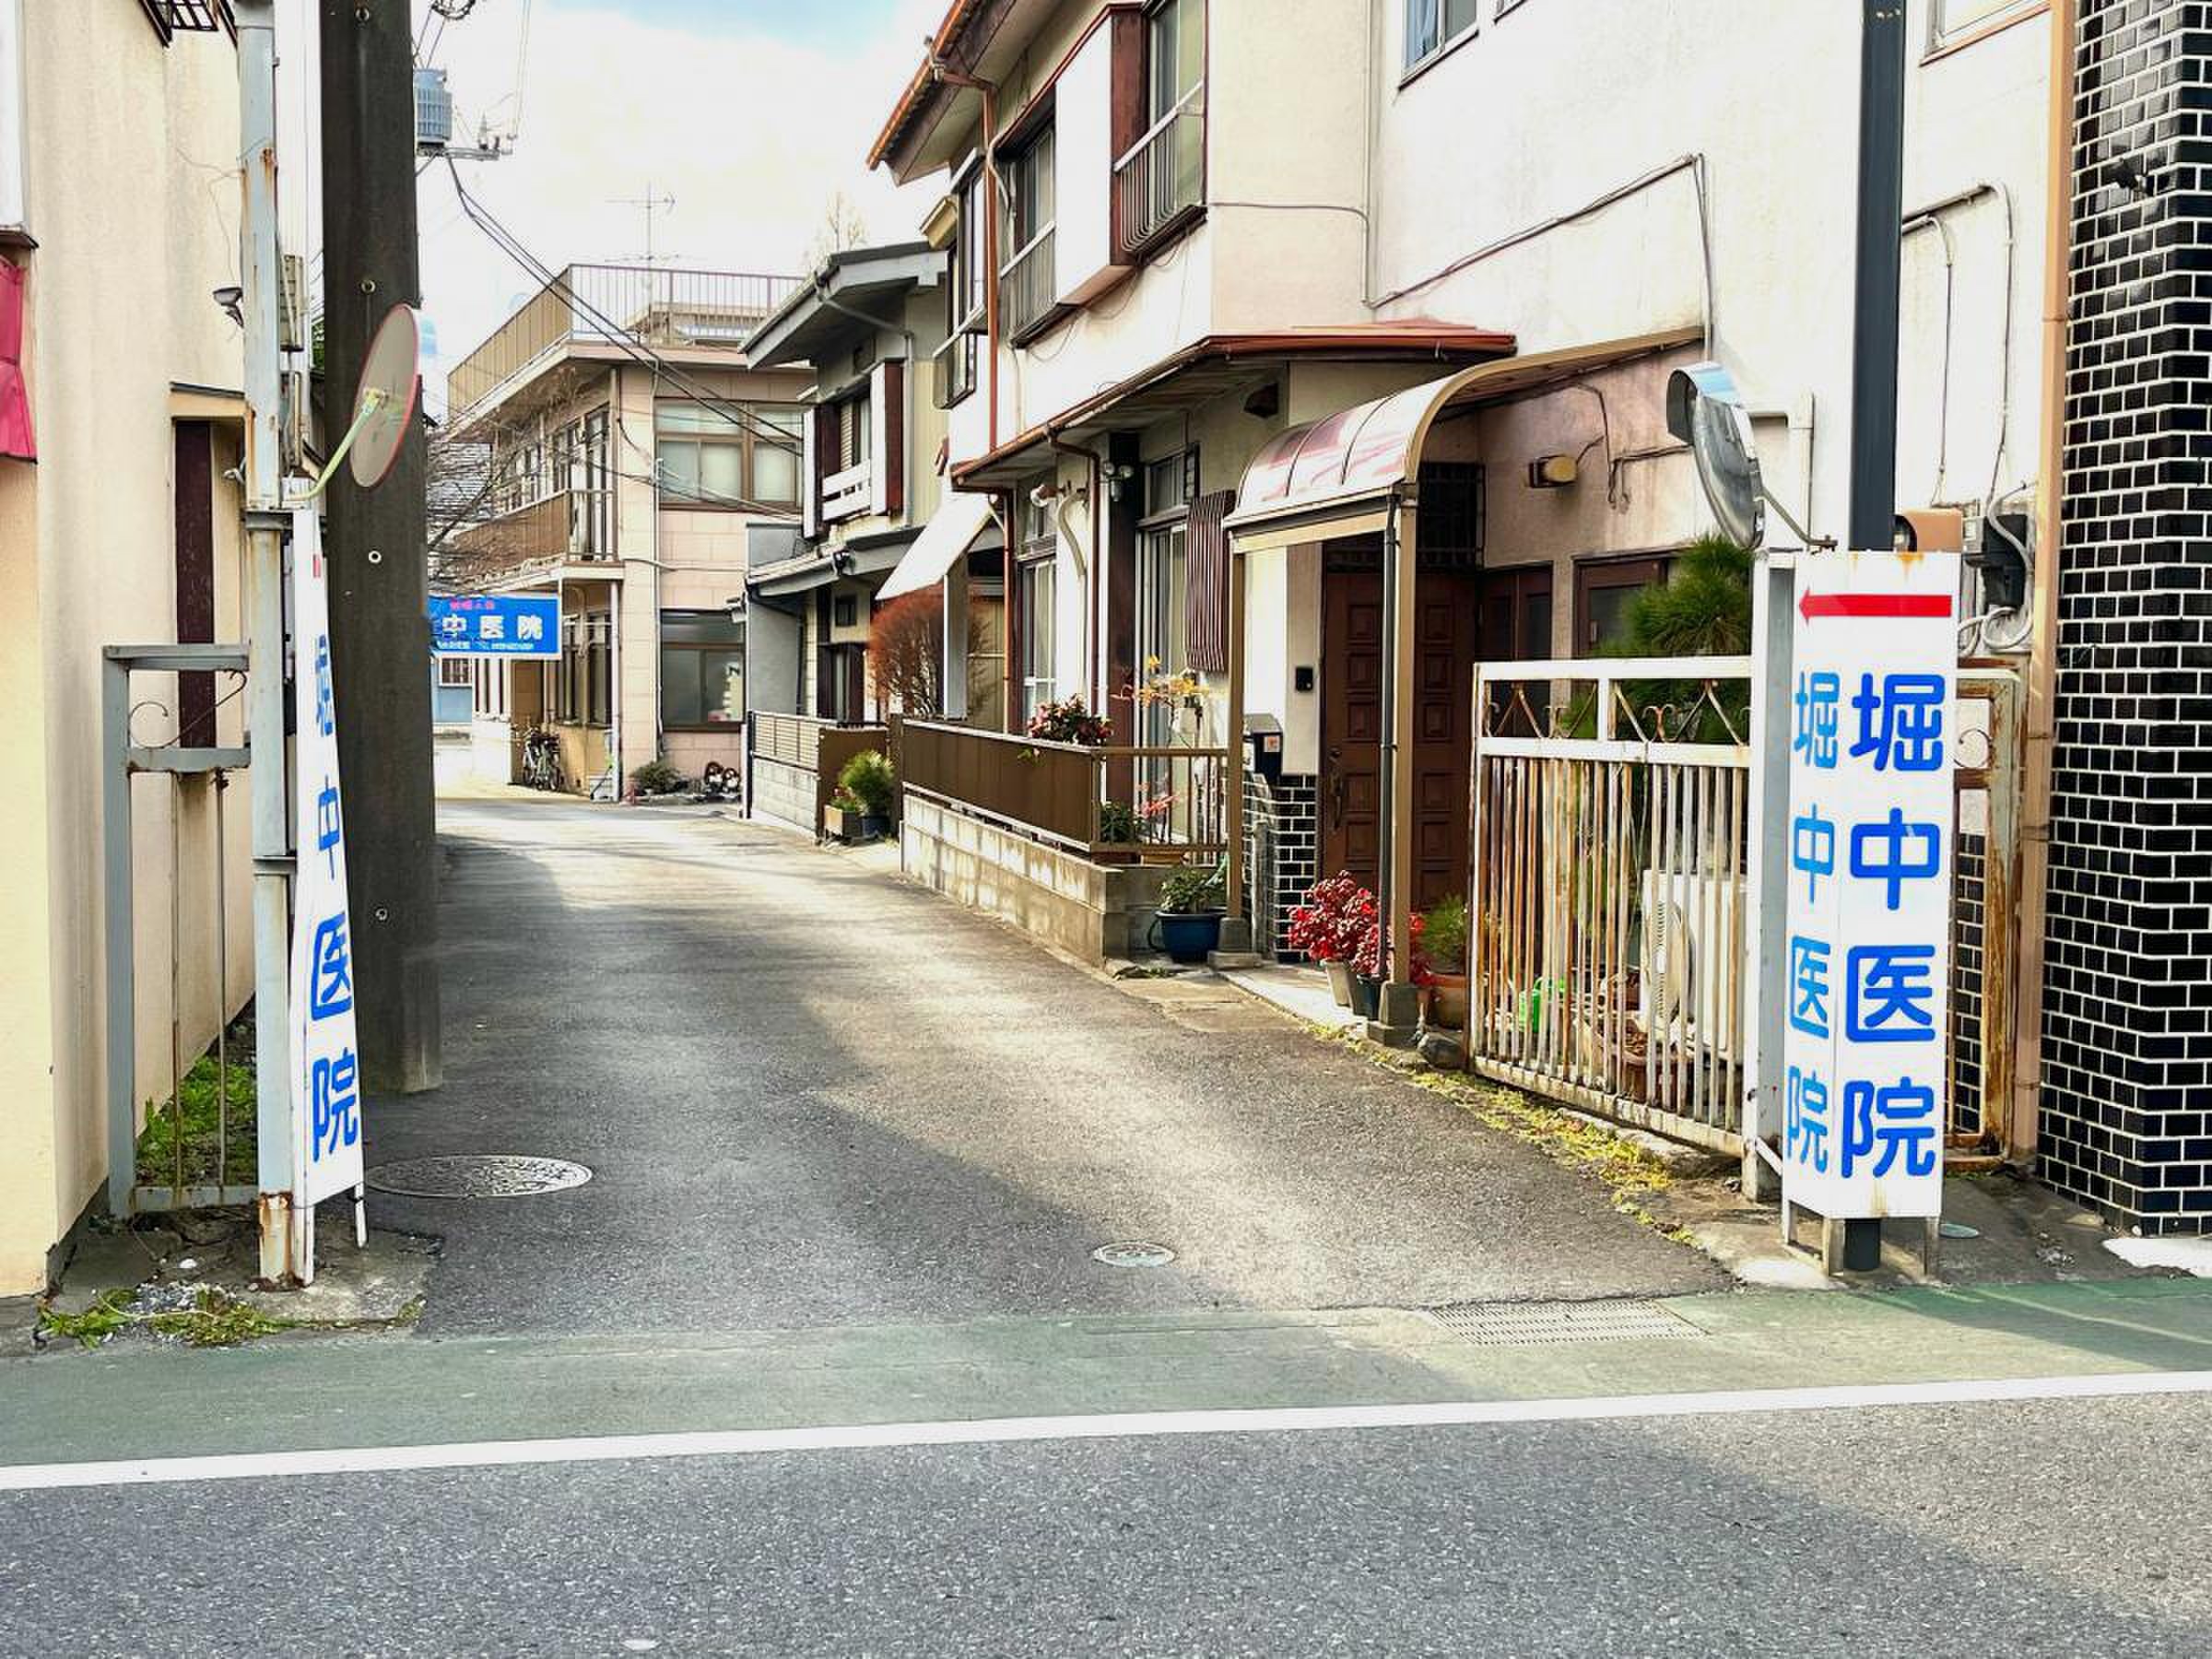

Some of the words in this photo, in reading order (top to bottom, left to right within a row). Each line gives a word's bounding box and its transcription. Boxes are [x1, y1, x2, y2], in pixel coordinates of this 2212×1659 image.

[433, 614, 542, 640] 中医院
[1787, 672, 1840, 1174] 堀中医院
[1841, 673, 1946, 1179] 堀中医院
